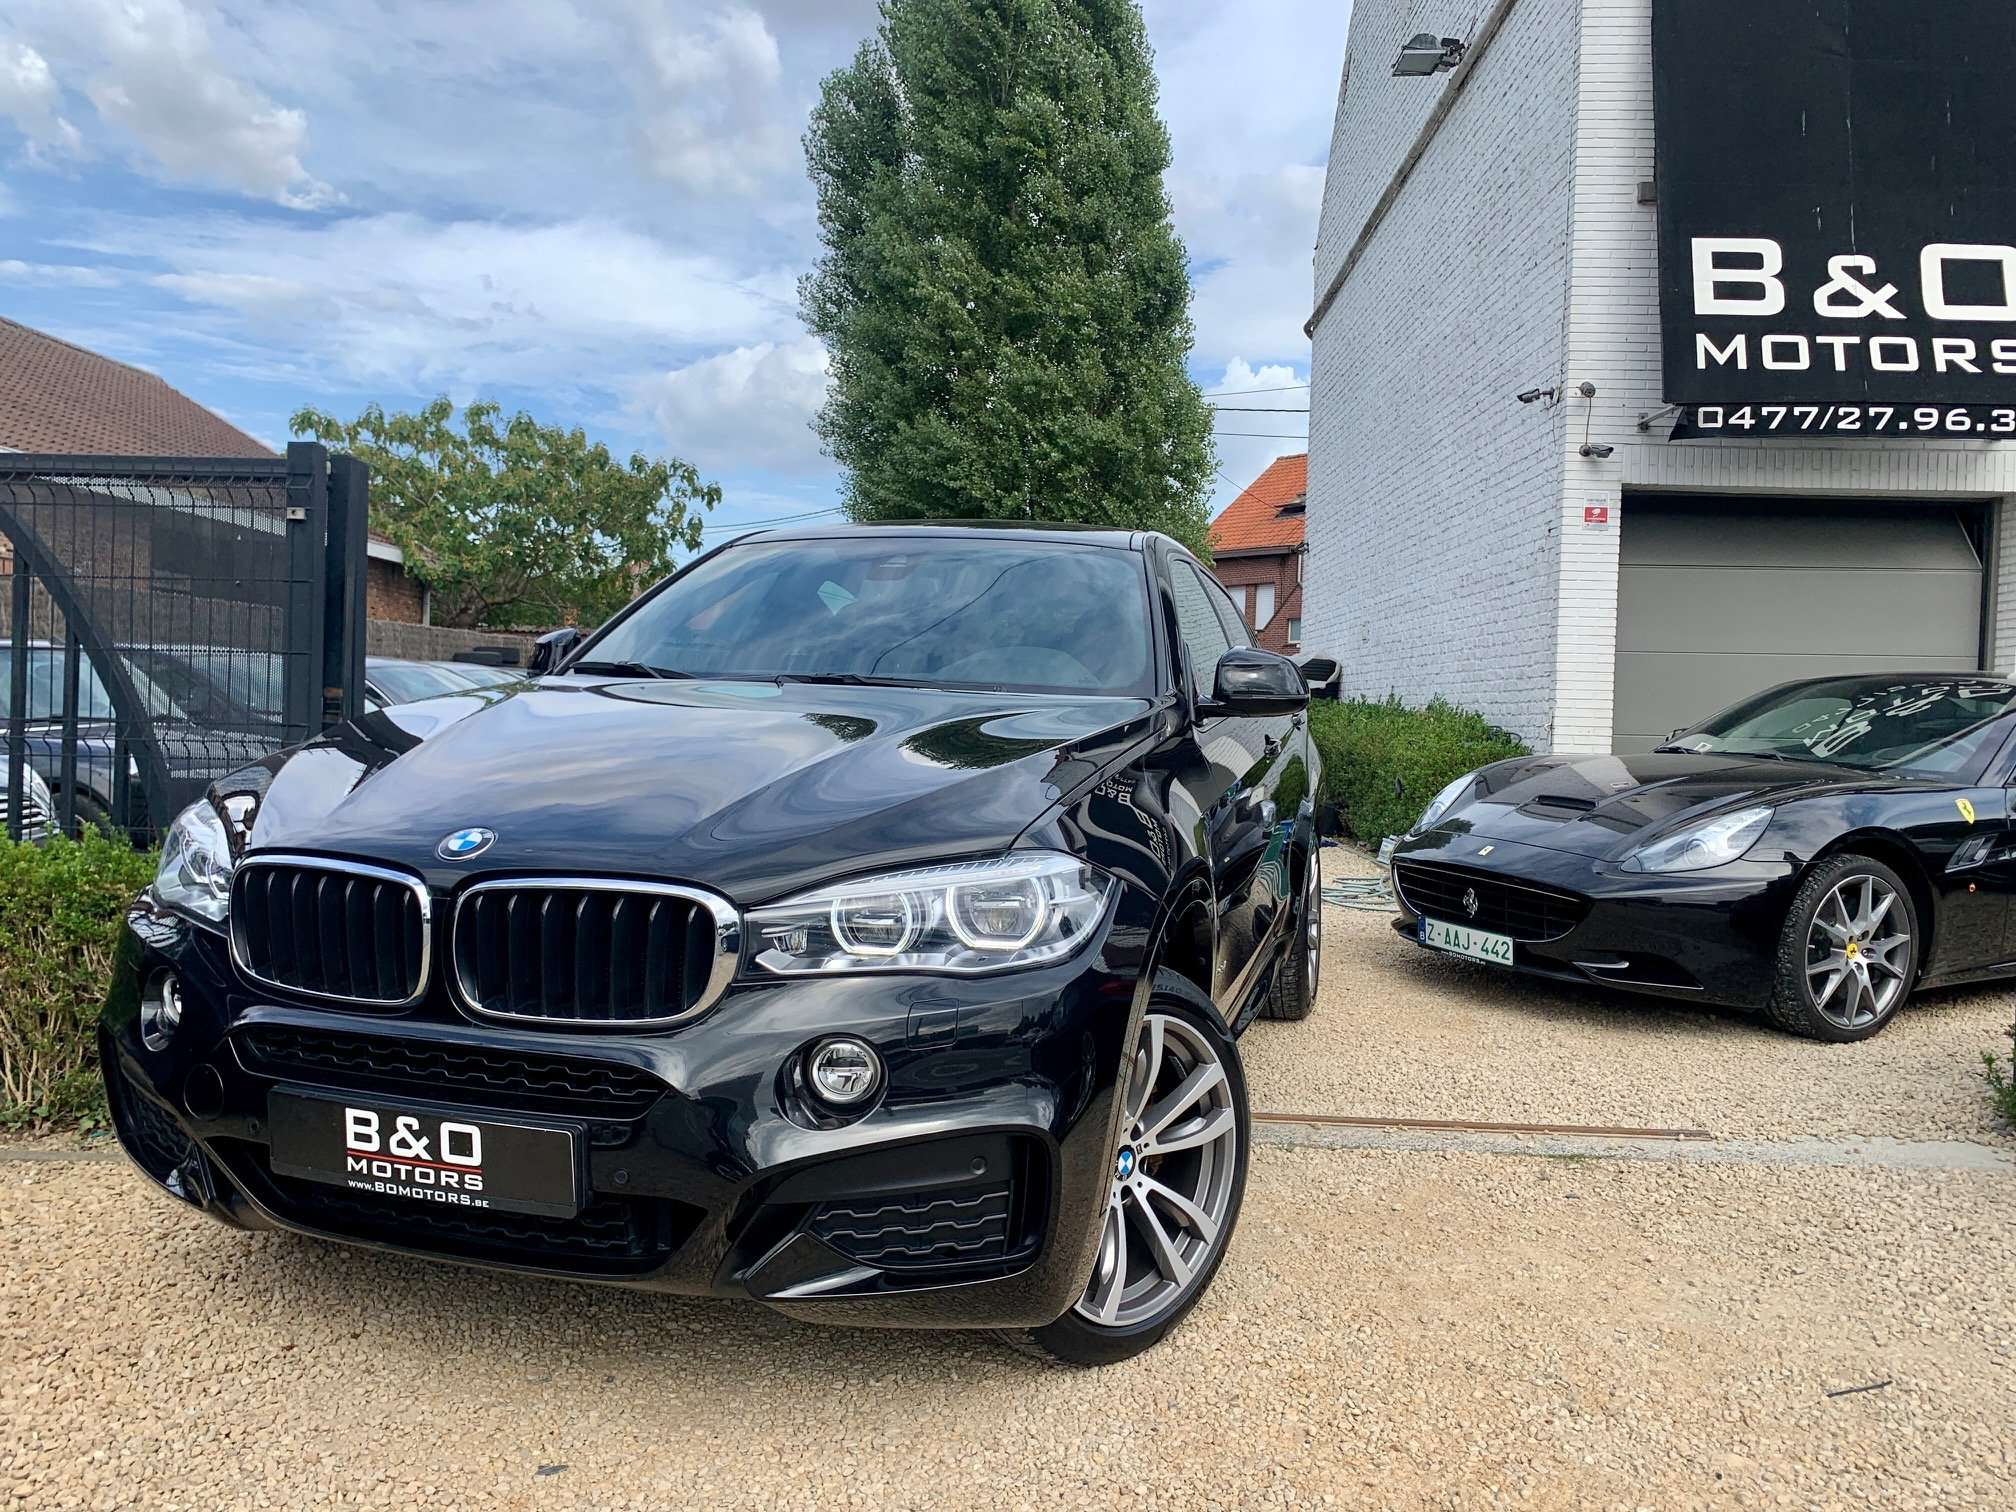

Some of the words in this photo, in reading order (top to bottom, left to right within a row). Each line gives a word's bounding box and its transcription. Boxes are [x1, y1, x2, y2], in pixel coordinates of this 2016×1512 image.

[1695, 333, 2016, 374] MOTORS
[1697, 405, 2015, 432] 0477/27.96.3
[1427, 923, 1511, 961] Z-AAJ-442
[345, 1107, 483, 1167] B&O
[347, 1156, 483, 1191] MOTORS
